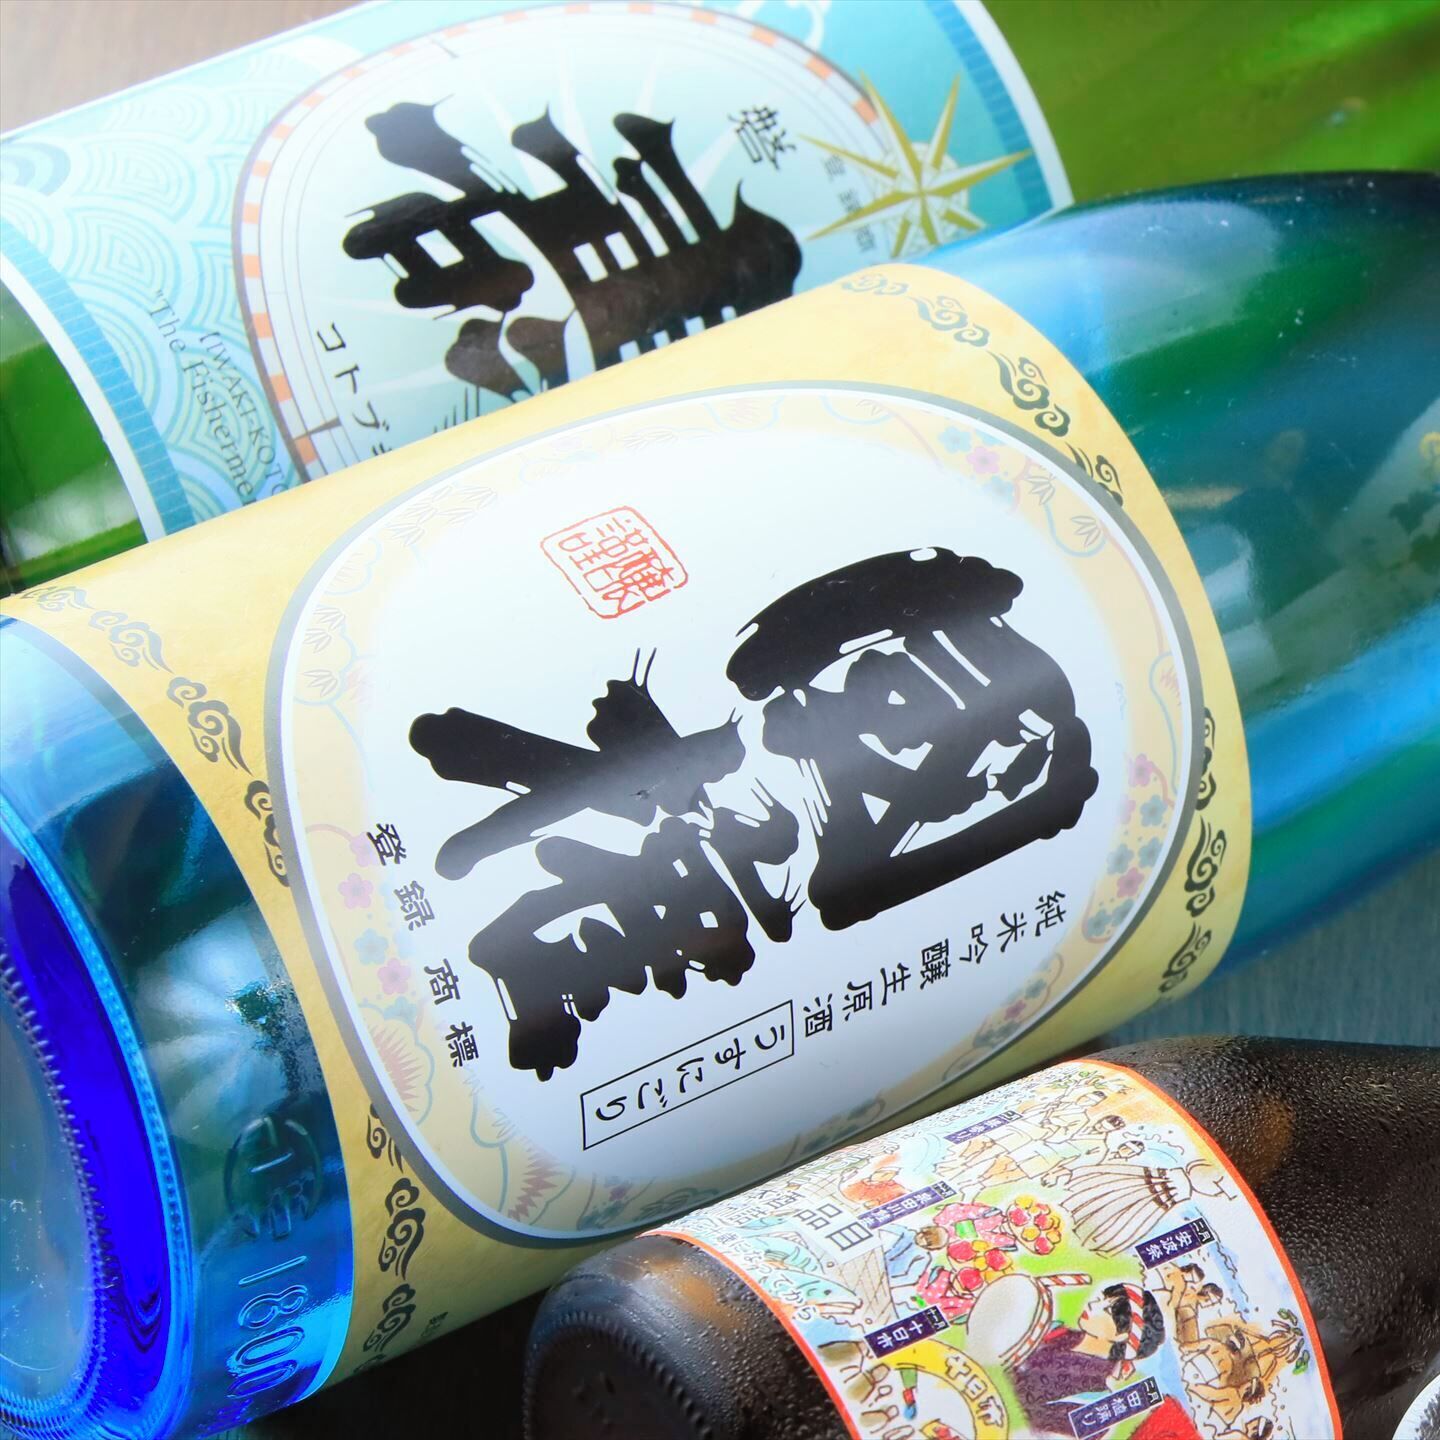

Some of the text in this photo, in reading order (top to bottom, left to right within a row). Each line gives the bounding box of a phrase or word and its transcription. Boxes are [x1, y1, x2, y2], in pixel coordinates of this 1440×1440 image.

[183, 360, 258, 506] Fisherme
[804, 889, 1067, 1038] 純米吟醸生原酒
[594, 1023, 786, 1123] うすにごり
[876, 1320, 924, 1350] 十日市
